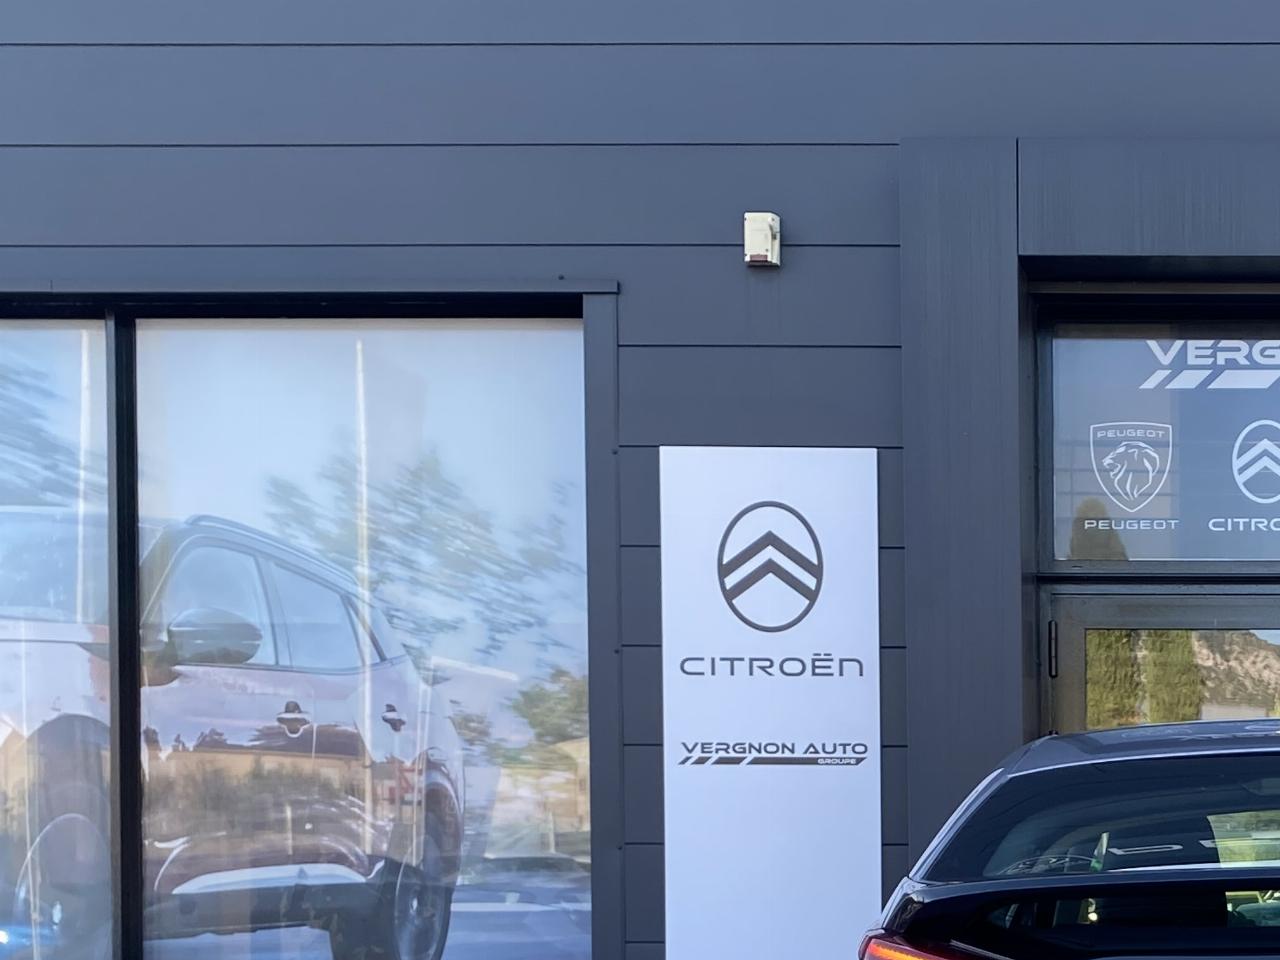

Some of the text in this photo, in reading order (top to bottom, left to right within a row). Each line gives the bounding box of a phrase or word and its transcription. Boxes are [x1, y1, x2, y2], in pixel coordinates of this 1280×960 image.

[1096, 428, 1166, 439] PEUGEOT
[1084, 519, 1179, 530] PEUGEOT
[679, 653, 864, 677] CITROËN
[681, 741, 868, 755] VERGNON AUTO
[817, 757, 857, 765] GROUPE
